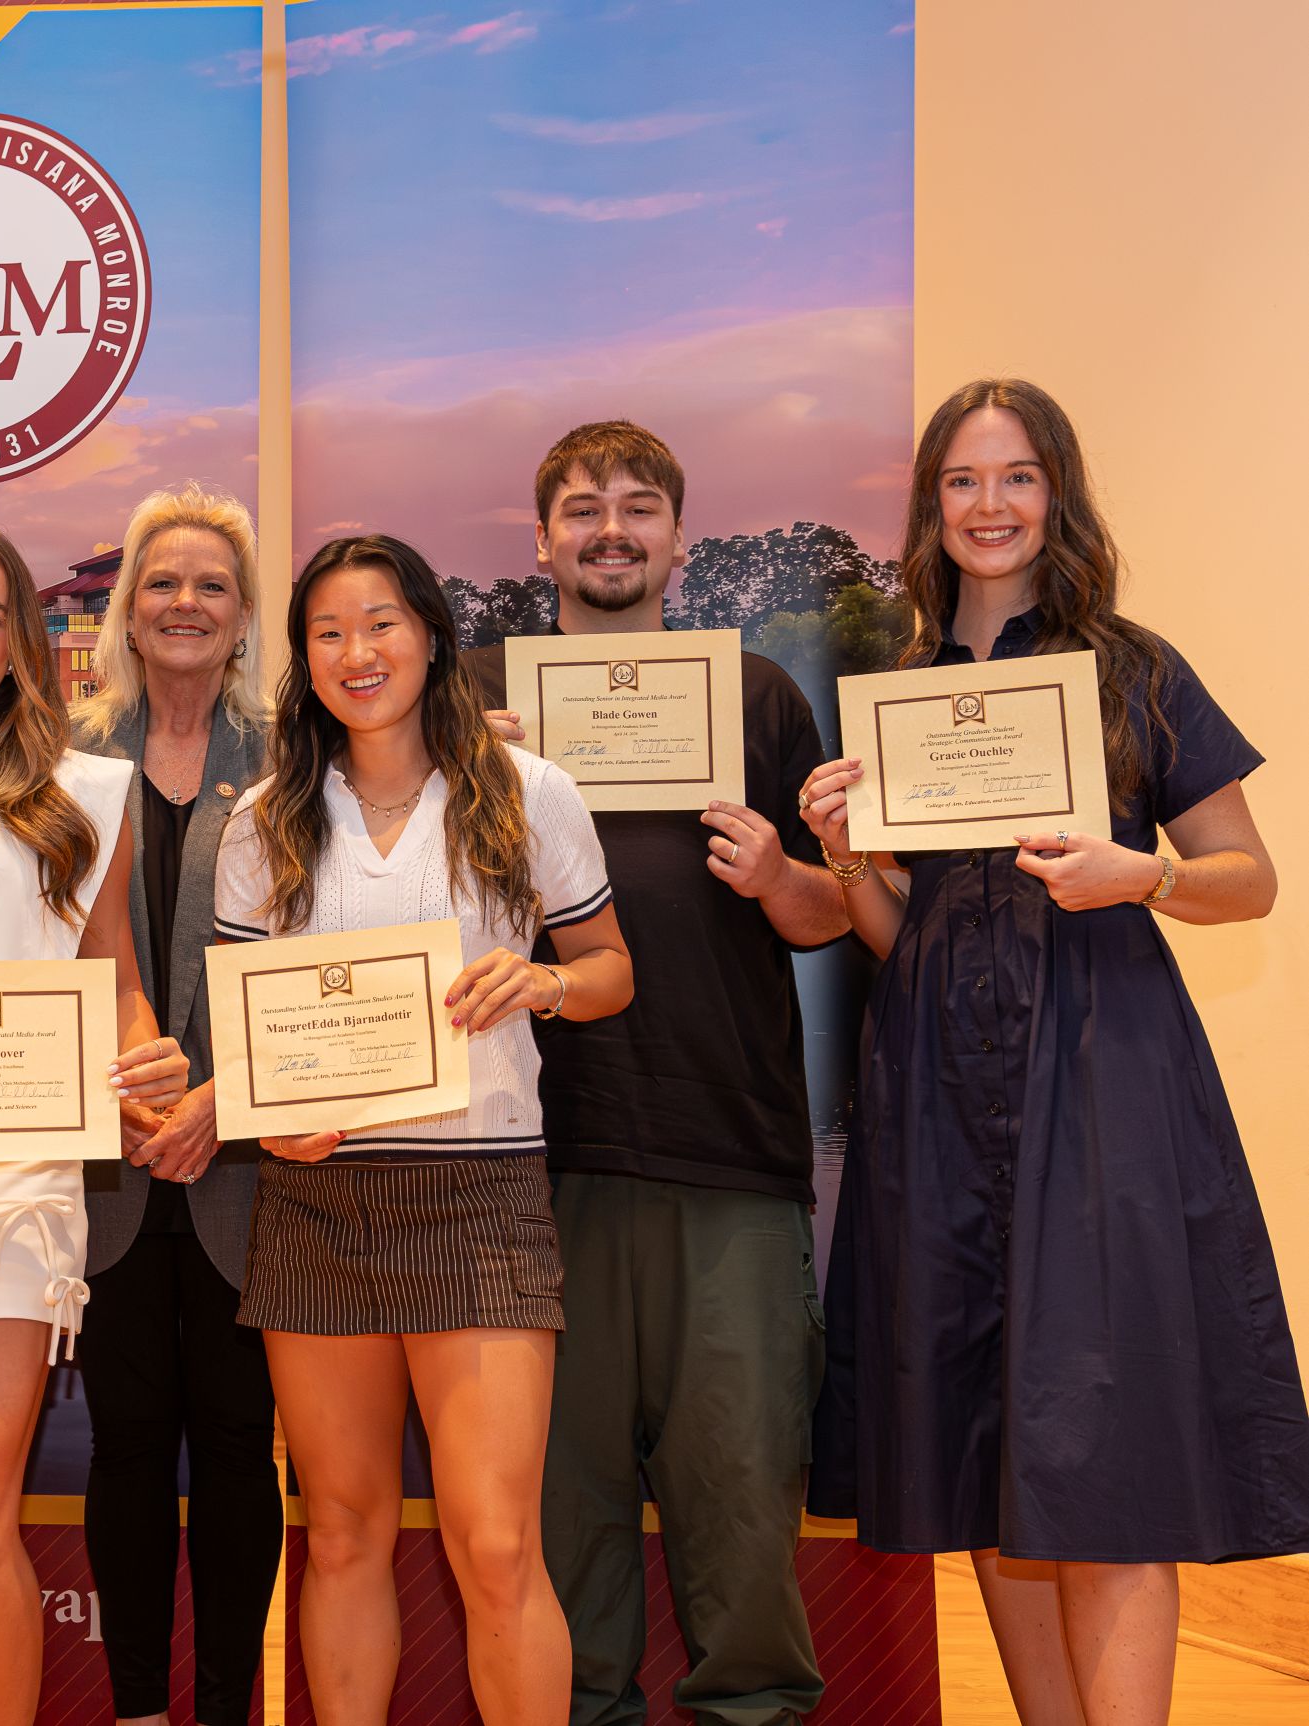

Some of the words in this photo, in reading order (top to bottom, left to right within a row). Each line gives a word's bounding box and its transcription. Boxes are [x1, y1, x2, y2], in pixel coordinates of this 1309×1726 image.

[93, 222, 131, 358] MONROE
[592, 710, 620, 720] Blade
[623, 710, 657, 719] Gowen
[926, 731, 962, 739] Outstanding
[963, 728, 991, 736] Graduate
[927, 739, 954, 747] Strategic
[955, 735, 1001, 744] Communication
[929, 750, 967, 761] Gracie
[969, 746, 1015, 758] Ouchley
[261, 1006, 297, 1015] Outstanding
[325, 998, 371, 1008] Communication
[394, 992, 414, 1000] Award
[266, 1018, 340, 1035] MargretEdda
[343, 1009, 412, 1027] Bjarnadottir
[332, 1070, 359, 1078] Education,
